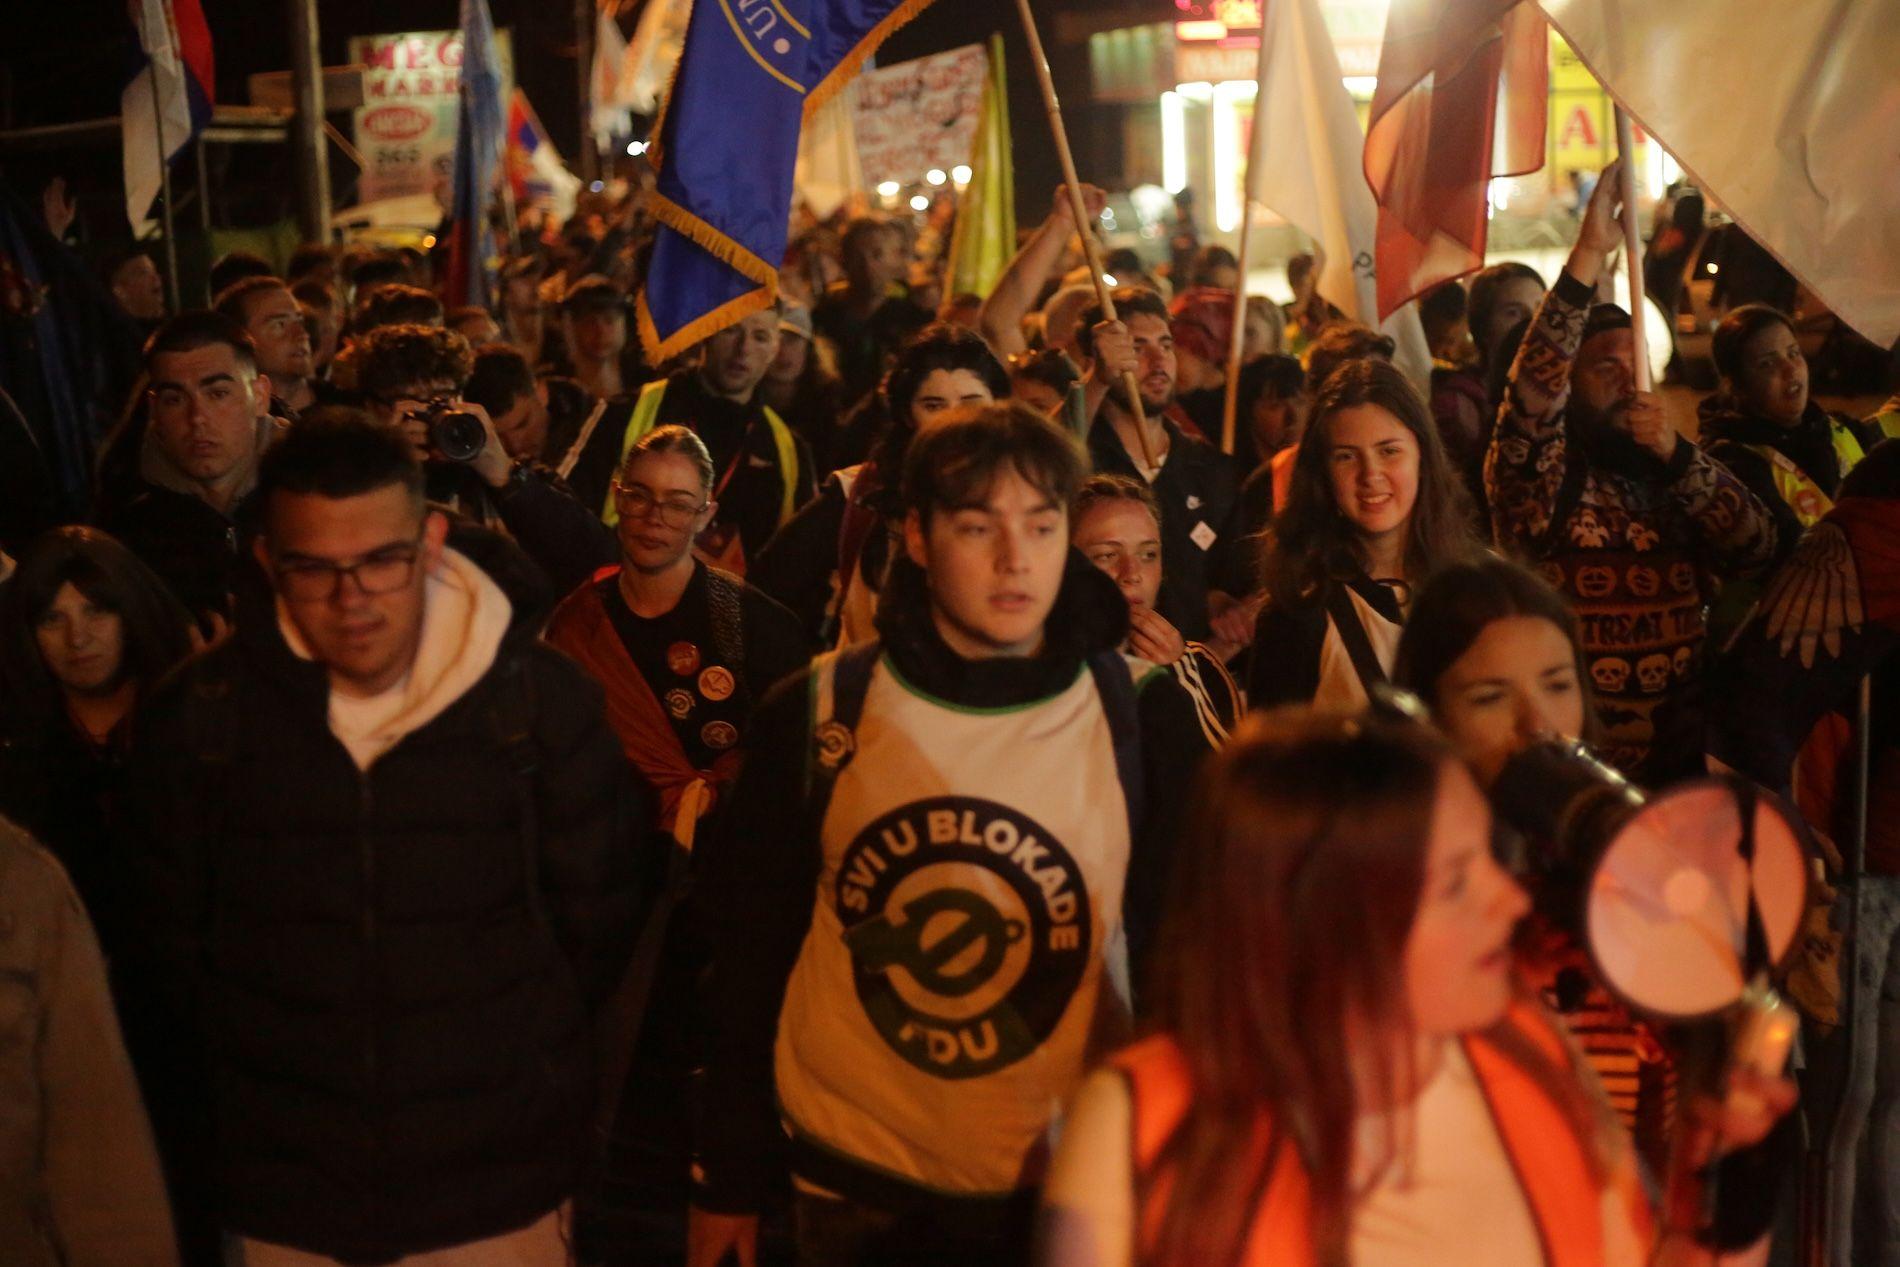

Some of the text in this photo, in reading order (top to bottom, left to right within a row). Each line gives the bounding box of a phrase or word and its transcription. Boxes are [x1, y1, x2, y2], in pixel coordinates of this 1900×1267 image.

[361, 36, 464, 69] MEG
[842, 809, 1080, 950] SVI U BLOKADE
